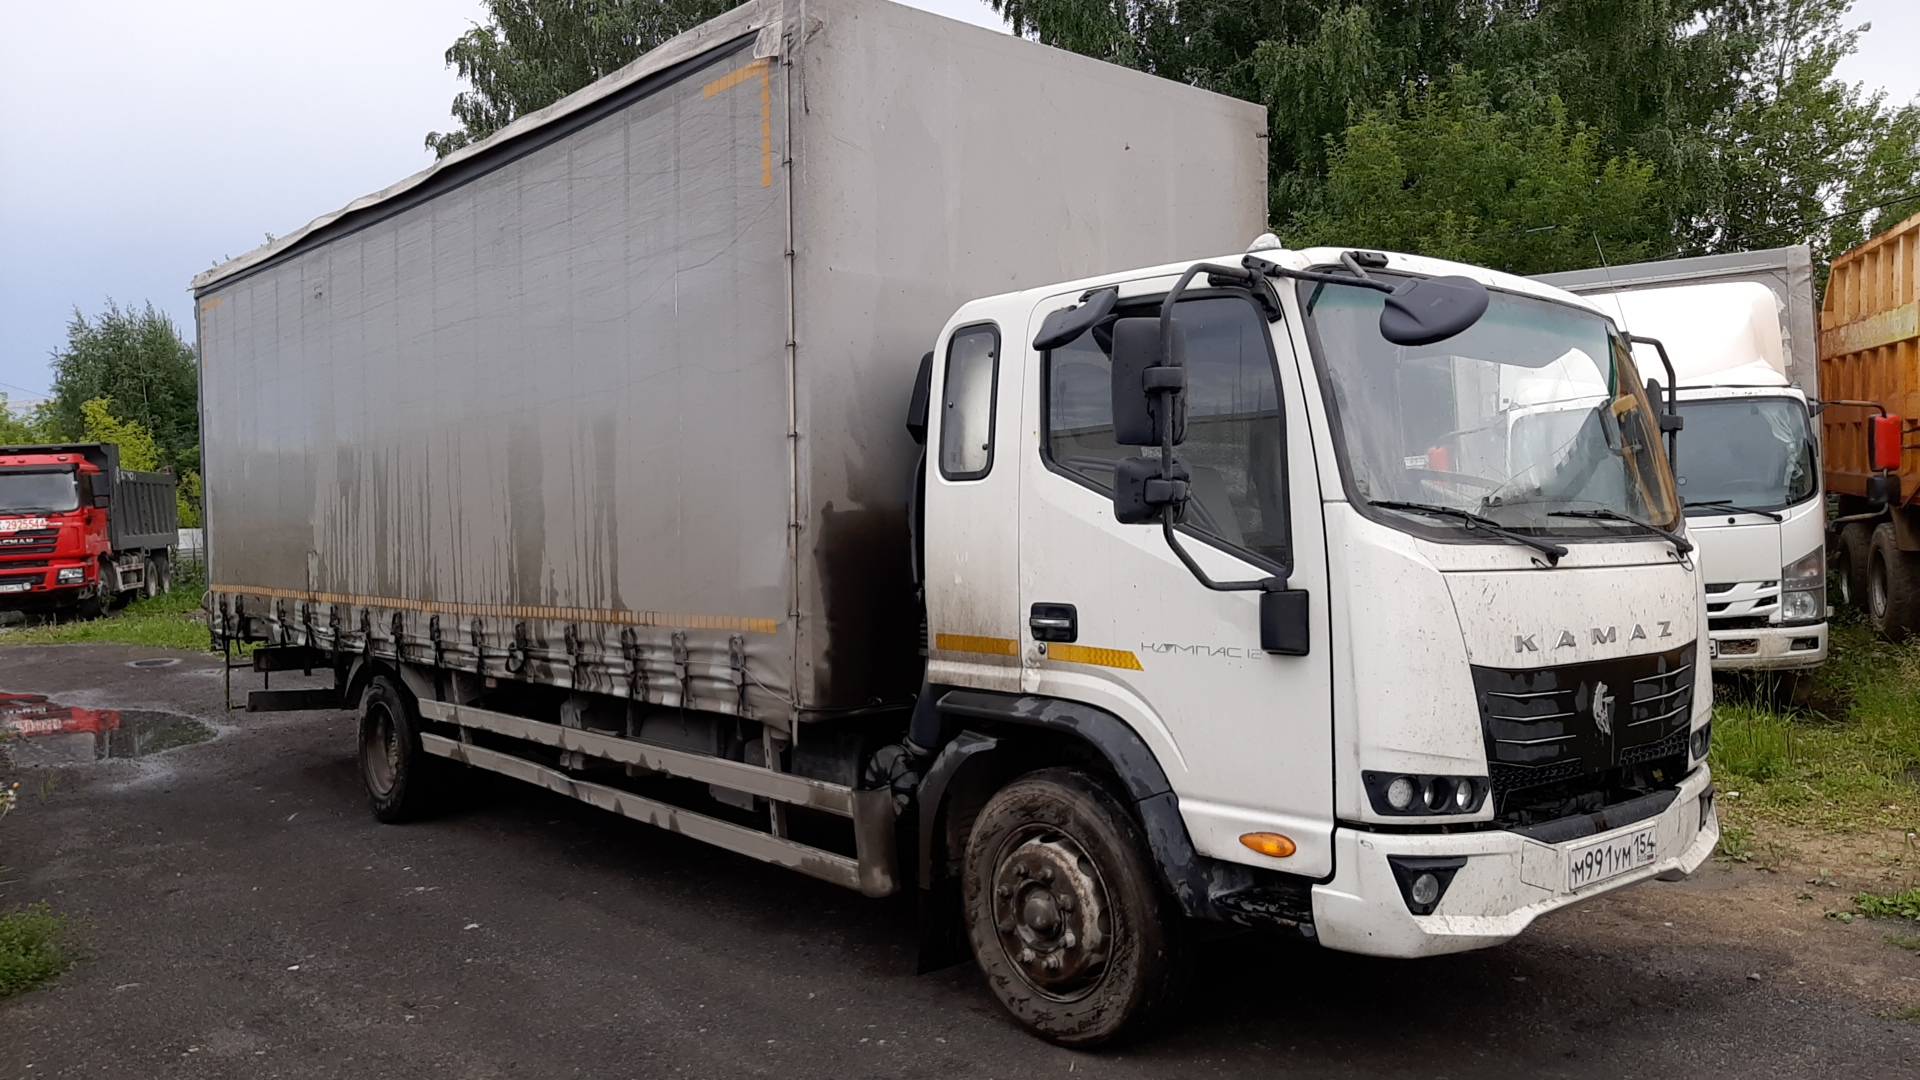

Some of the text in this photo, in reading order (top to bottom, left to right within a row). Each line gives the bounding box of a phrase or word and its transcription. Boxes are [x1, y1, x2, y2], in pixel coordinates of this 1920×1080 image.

[1513, 620, 1672, 653] KAMAZ
[1572, 832, 1656, 884] М991УМ 154
